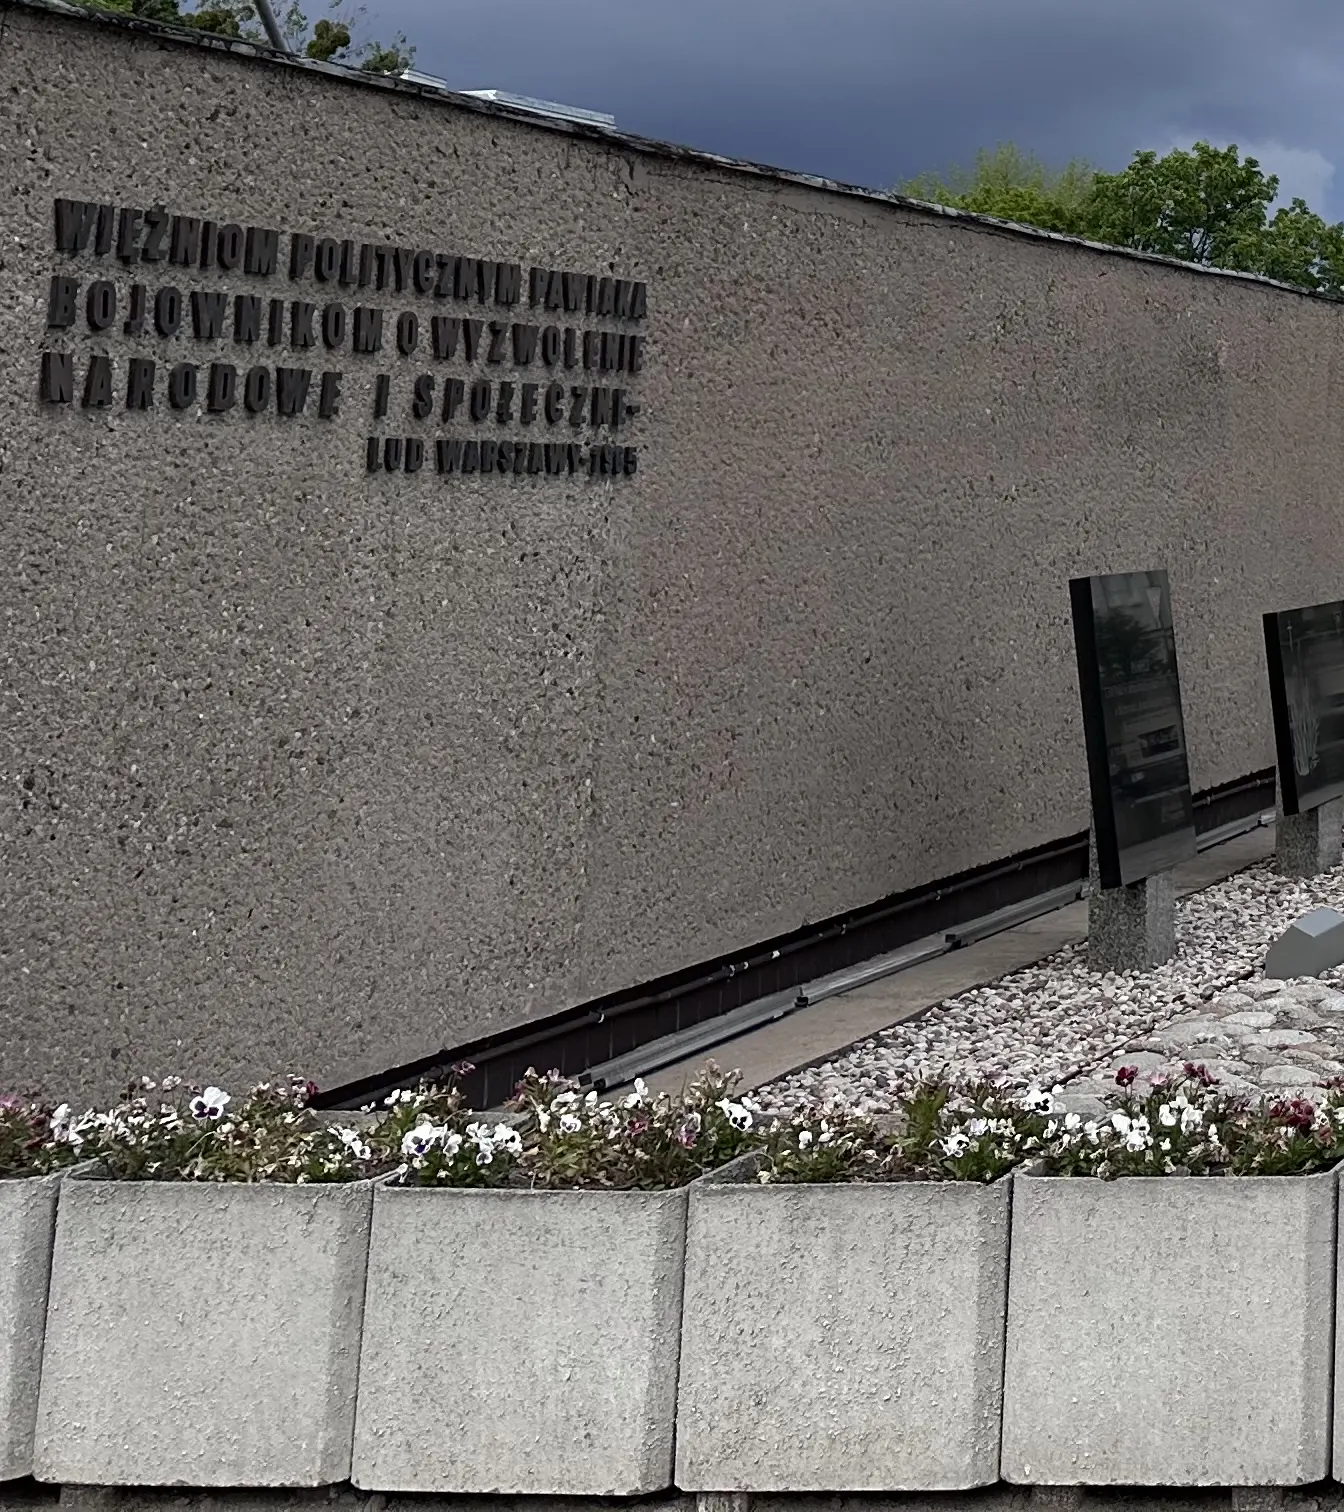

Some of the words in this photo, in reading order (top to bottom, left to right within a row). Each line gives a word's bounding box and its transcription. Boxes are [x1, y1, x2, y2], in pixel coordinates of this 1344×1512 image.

[289, 232, 521, 305] POLITYCZNYM
[529, 267, 647, 318] PAWIAKA
[47, 275, 383, 353] BOJOWNIKOM
[396, 311, 419, 356] O
[431, 315, 647, 372] WYZWOLENIE
[40, 352, 343, 419] NARODOWE
[374, 374, 391, 418] I
[367, 437, 424, 474] LUD
